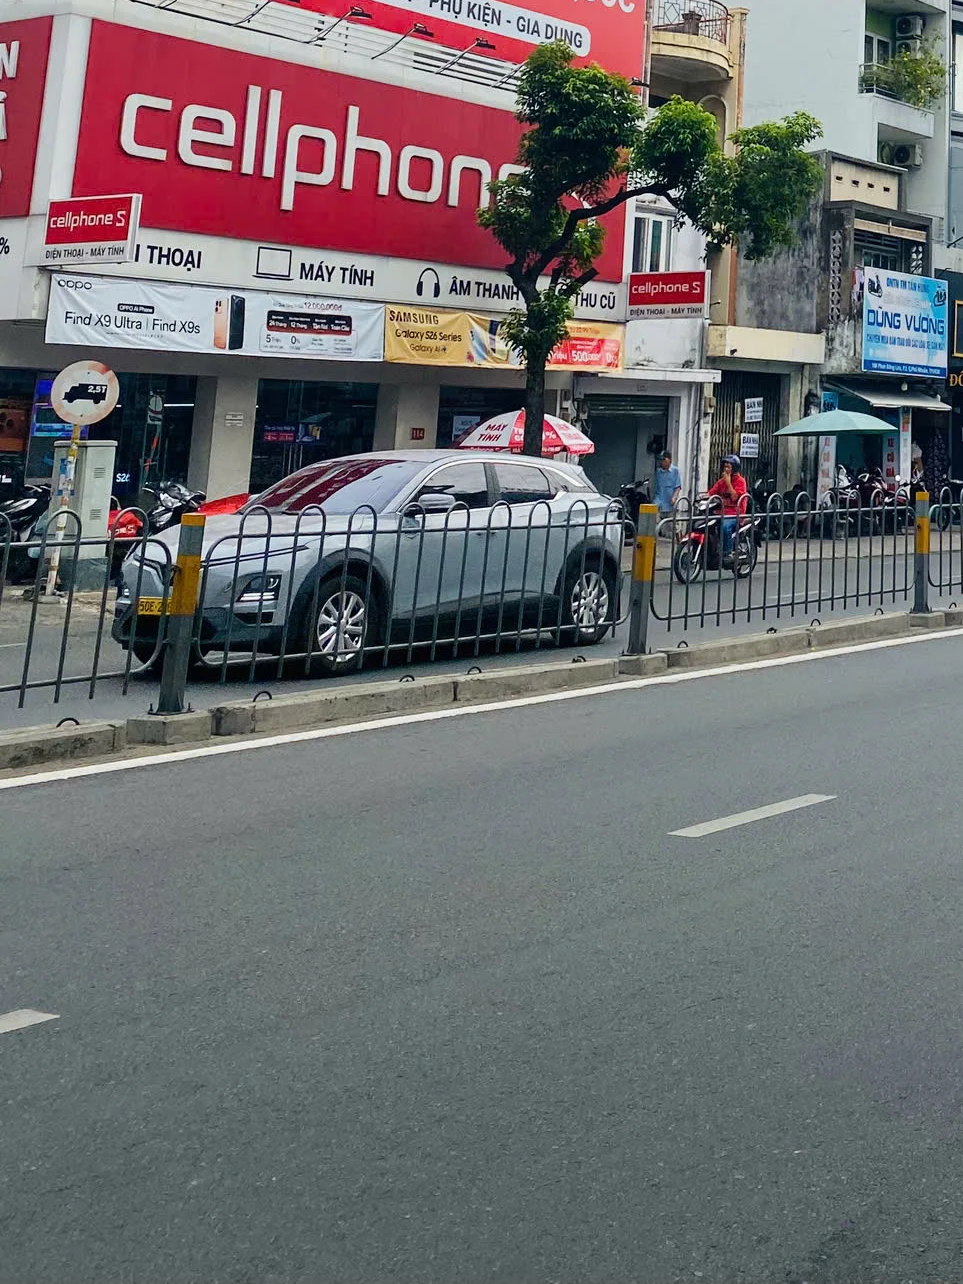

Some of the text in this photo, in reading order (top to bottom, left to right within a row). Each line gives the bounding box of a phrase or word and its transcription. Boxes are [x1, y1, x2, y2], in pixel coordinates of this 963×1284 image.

[467, 3, 502, 27] KIỆN
[516, 16, 541, 38] GIA
[50, 211, 113, 232] cellphone
[45, 248, 62, 260] ĐIỆN
[63, 248, 84, 259] THOẠI
[90, 246, 106, 257] MÁY
[107, 246, 125, 256] TÍNH
[147, 245, 202, 272] THOẠI
[300, 261, 375, 287] MÁY TÍNH
[449, 276, 520, 301] ÂM THANH
[632, 281, 690, 296] cellphone
[600, 291, 617, 310] CŨ
[64, 311, 91, 326] Find
[94, 314, 111, 327] X9
[114, 315, 142, 330] Ultra
[152, 318, 176, 332] Find
[178, 321, 201, 334] X9s
[389, 309, 439, 325] SAMSUNG
[867, 306, 901, 330] DŨNG
[395, 328, 424, 341] Galaxy
[439, 332, 462, 343] Series
